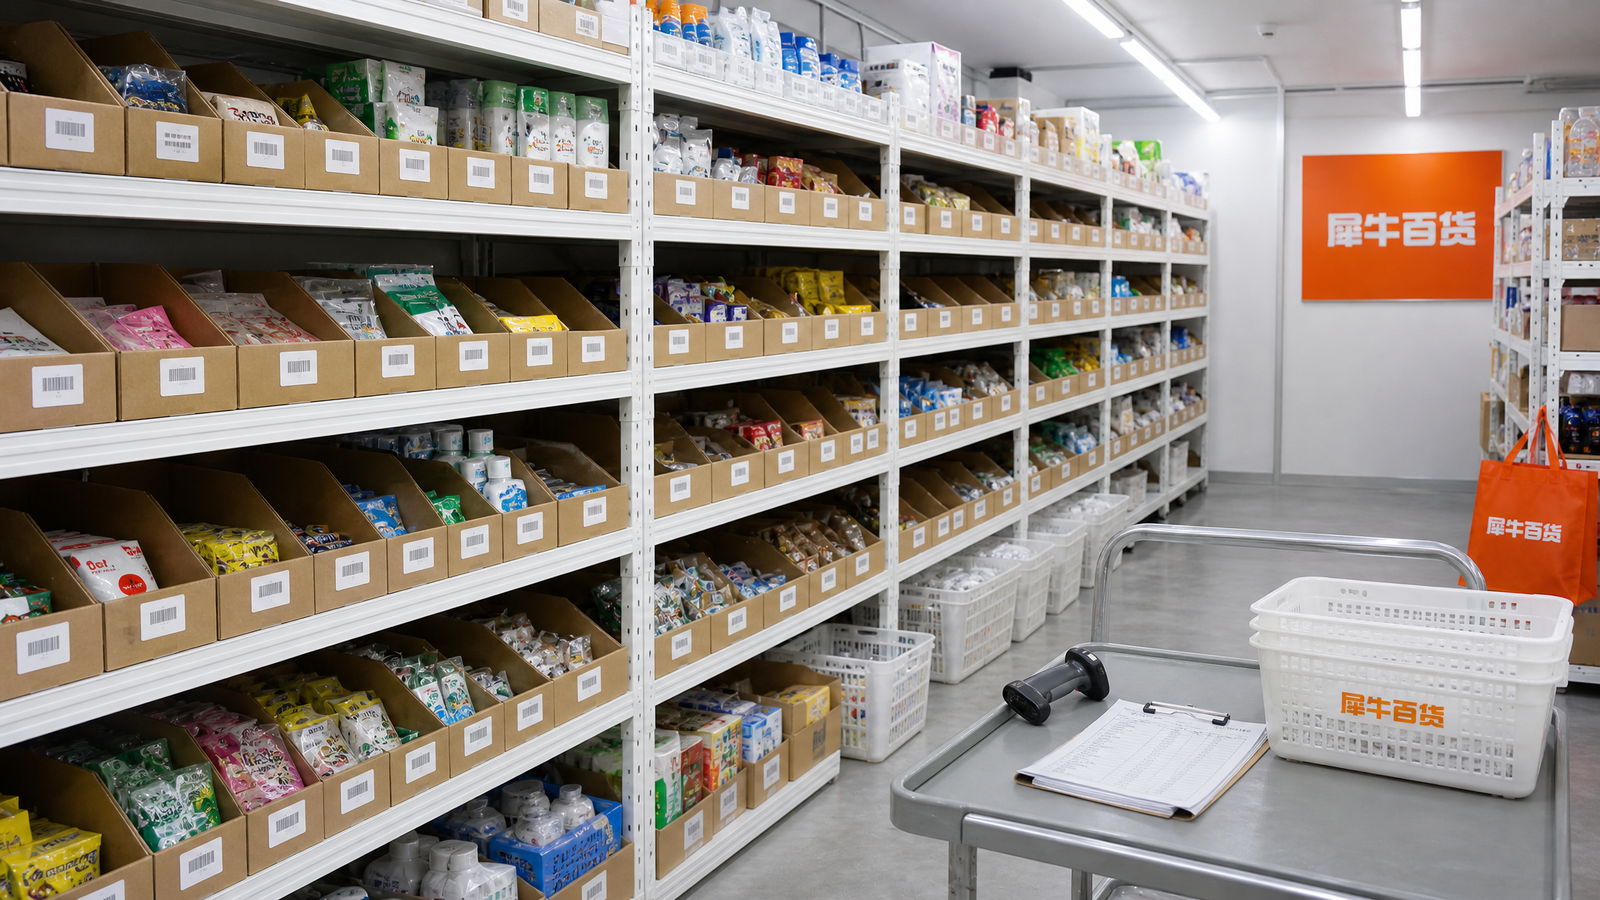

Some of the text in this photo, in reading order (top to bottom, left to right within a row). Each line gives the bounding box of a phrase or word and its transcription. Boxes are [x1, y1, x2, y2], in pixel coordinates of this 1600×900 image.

[1327, 211, 1476, 248] 犀牛百货
[1486, 516, 1562, 543] 犀牛百货
[1340, 692, 1445, 729] 犀牛百货
